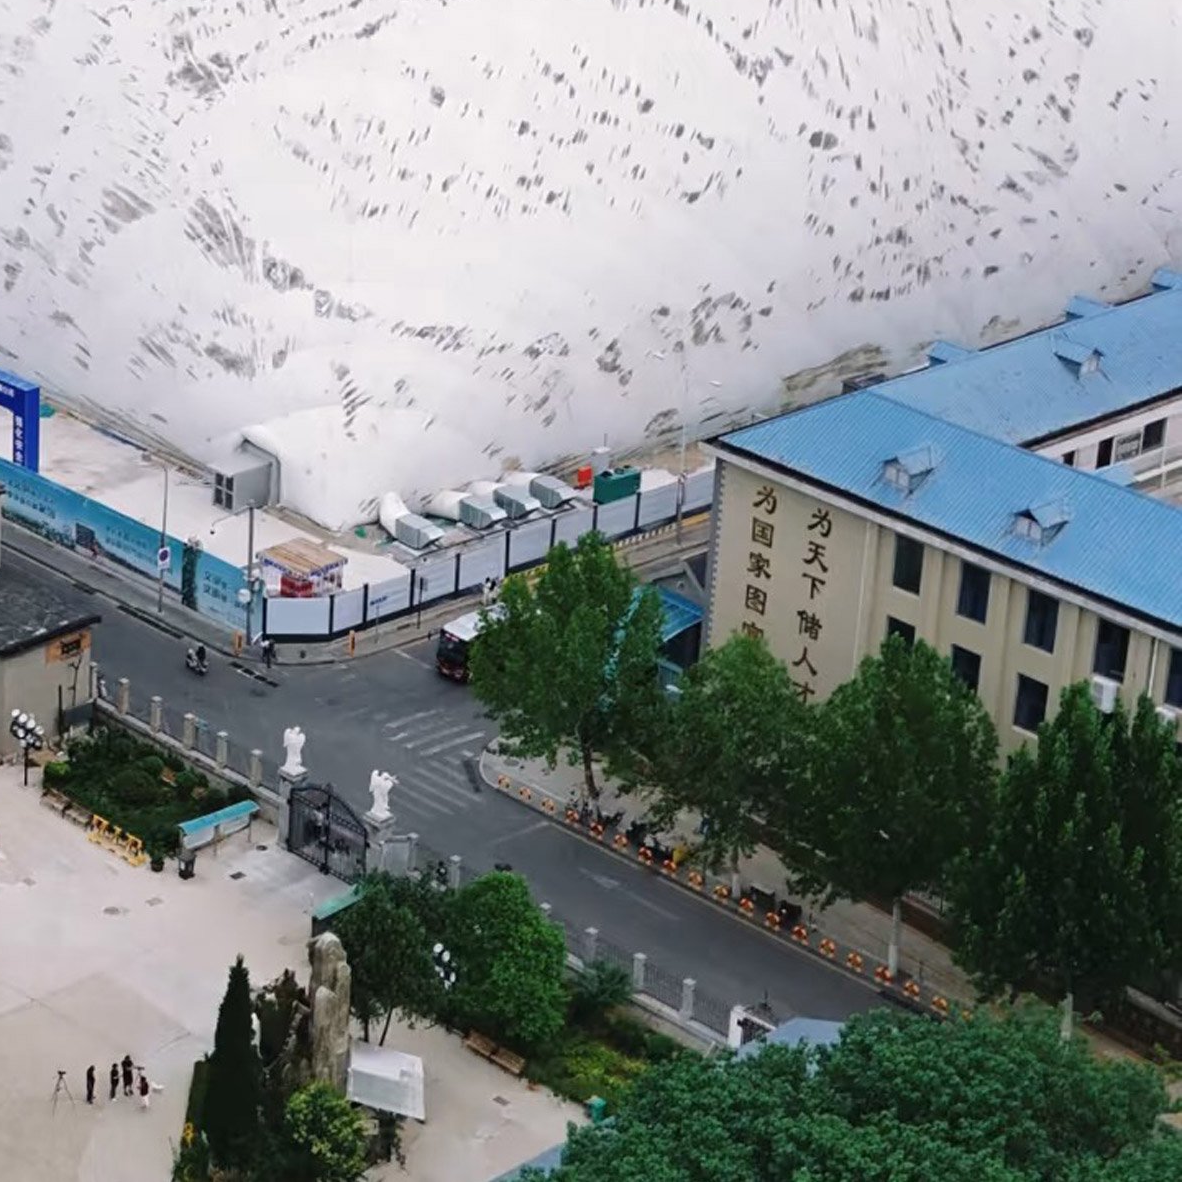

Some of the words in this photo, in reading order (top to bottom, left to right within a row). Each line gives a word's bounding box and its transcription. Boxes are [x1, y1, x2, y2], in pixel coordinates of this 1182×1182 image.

[792, 509, 832, 703] 为天下储人才
